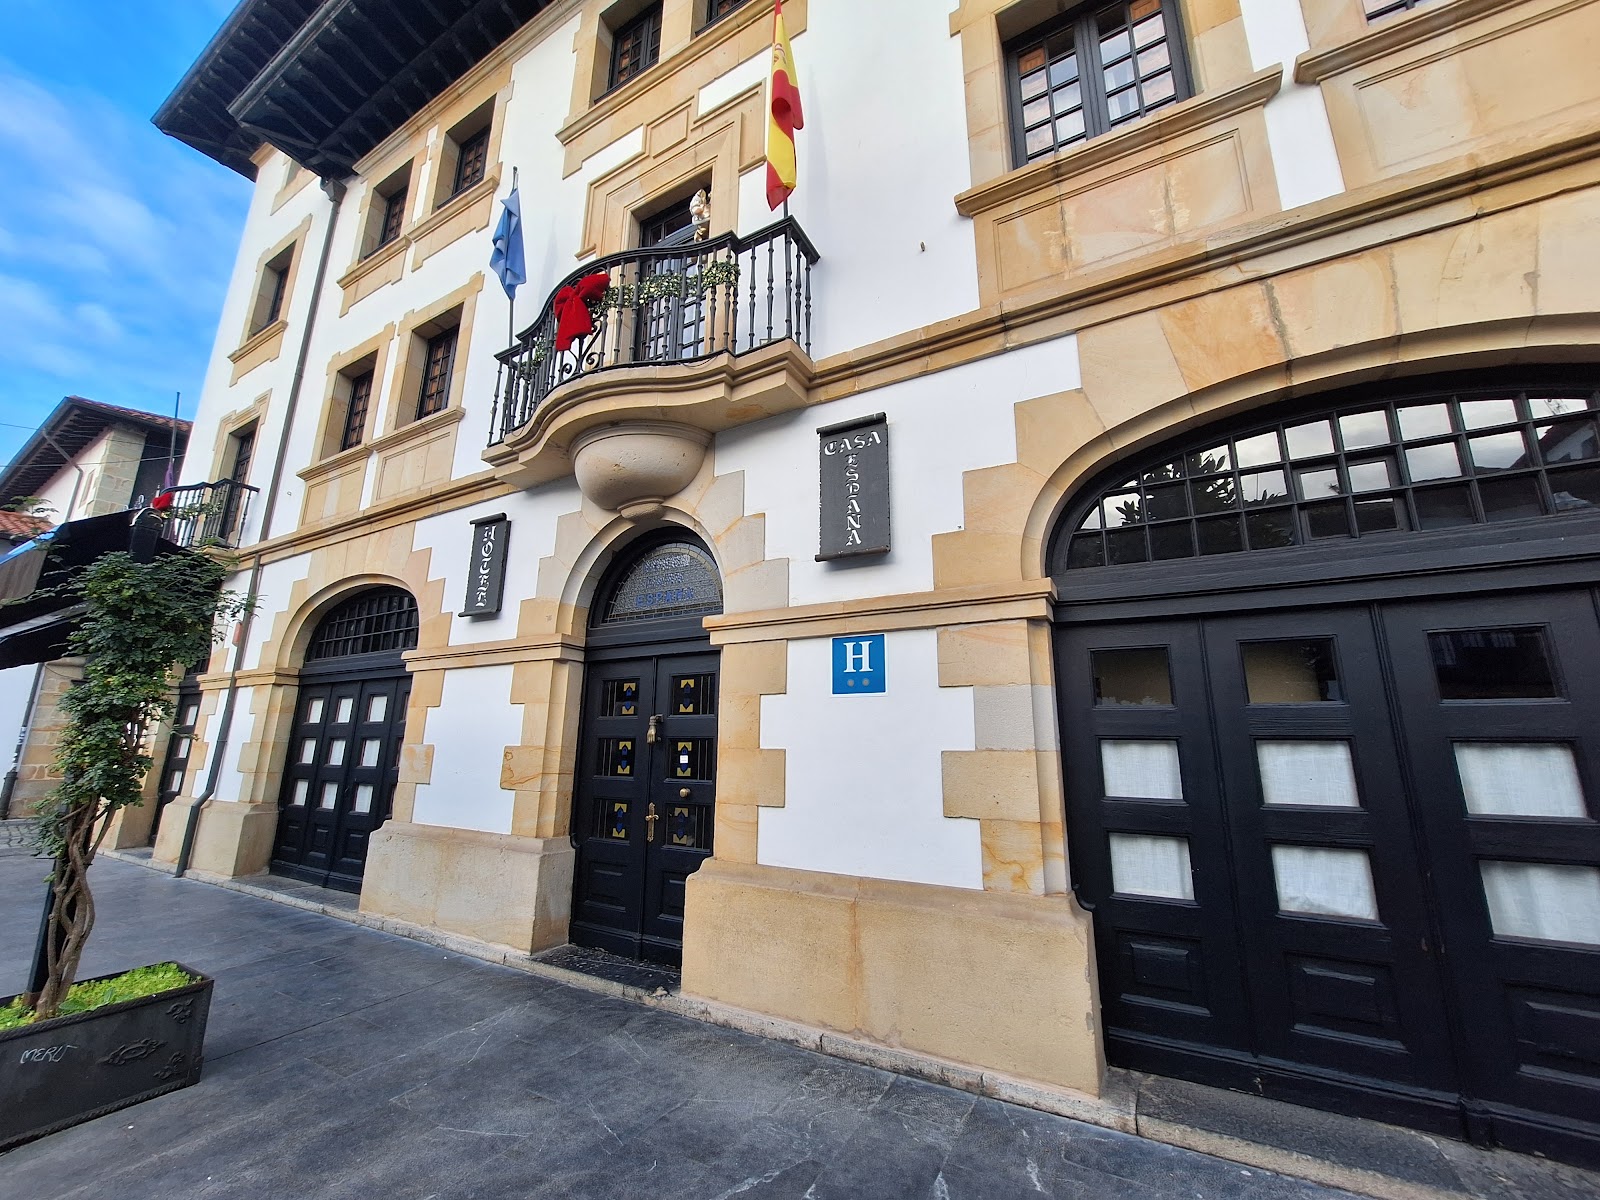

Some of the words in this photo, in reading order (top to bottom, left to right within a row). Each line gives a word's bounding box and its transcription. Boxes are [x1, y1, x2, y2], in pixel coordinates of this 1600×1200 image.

[824, 431, 882, 456] CASA
[844, 452, 862, 547] ESPAÑA
[475, 525, 497, 607] HOTEL
[843, 640, 874, 673] H
